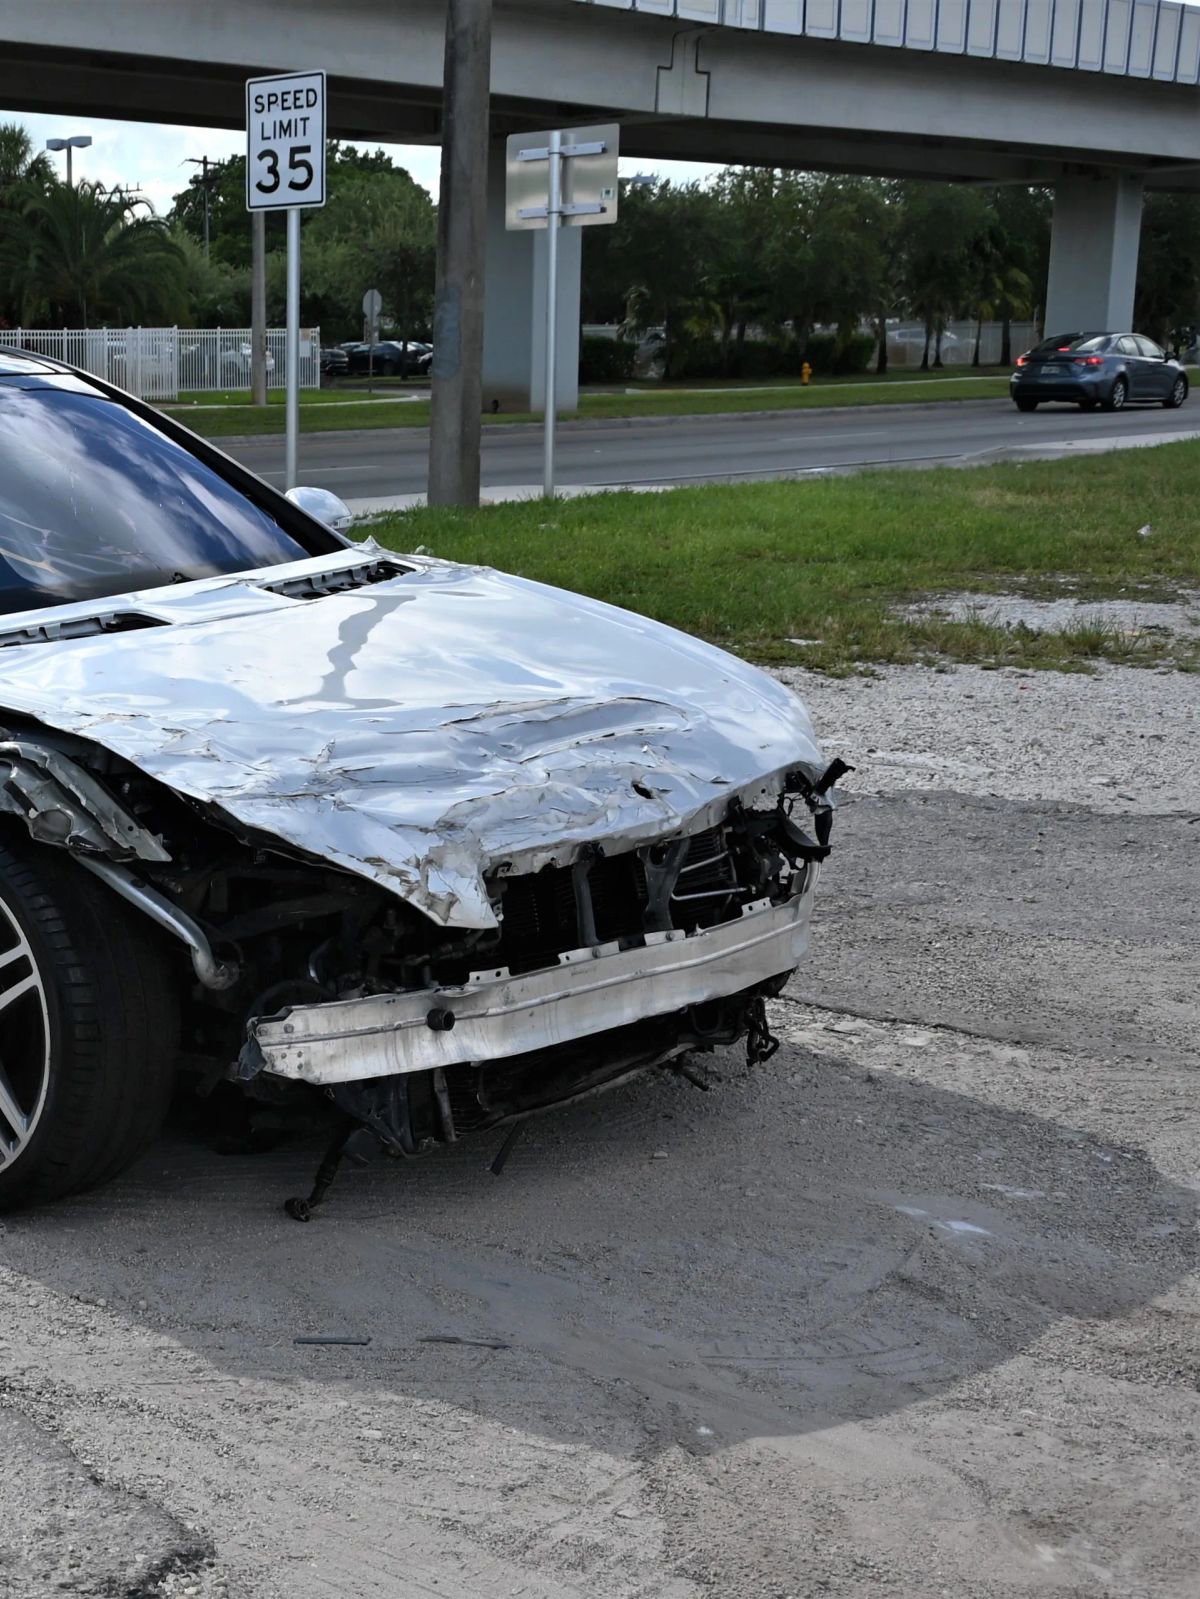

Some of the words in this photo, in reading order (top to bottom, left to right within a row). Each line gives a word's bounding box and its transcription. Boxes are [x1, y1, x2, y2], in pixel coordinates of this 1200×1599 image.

[254, 88, 318, 114] SPEED
[261, 116, 311, 141] LIMIT
[255, 144, 314, 194] 35
